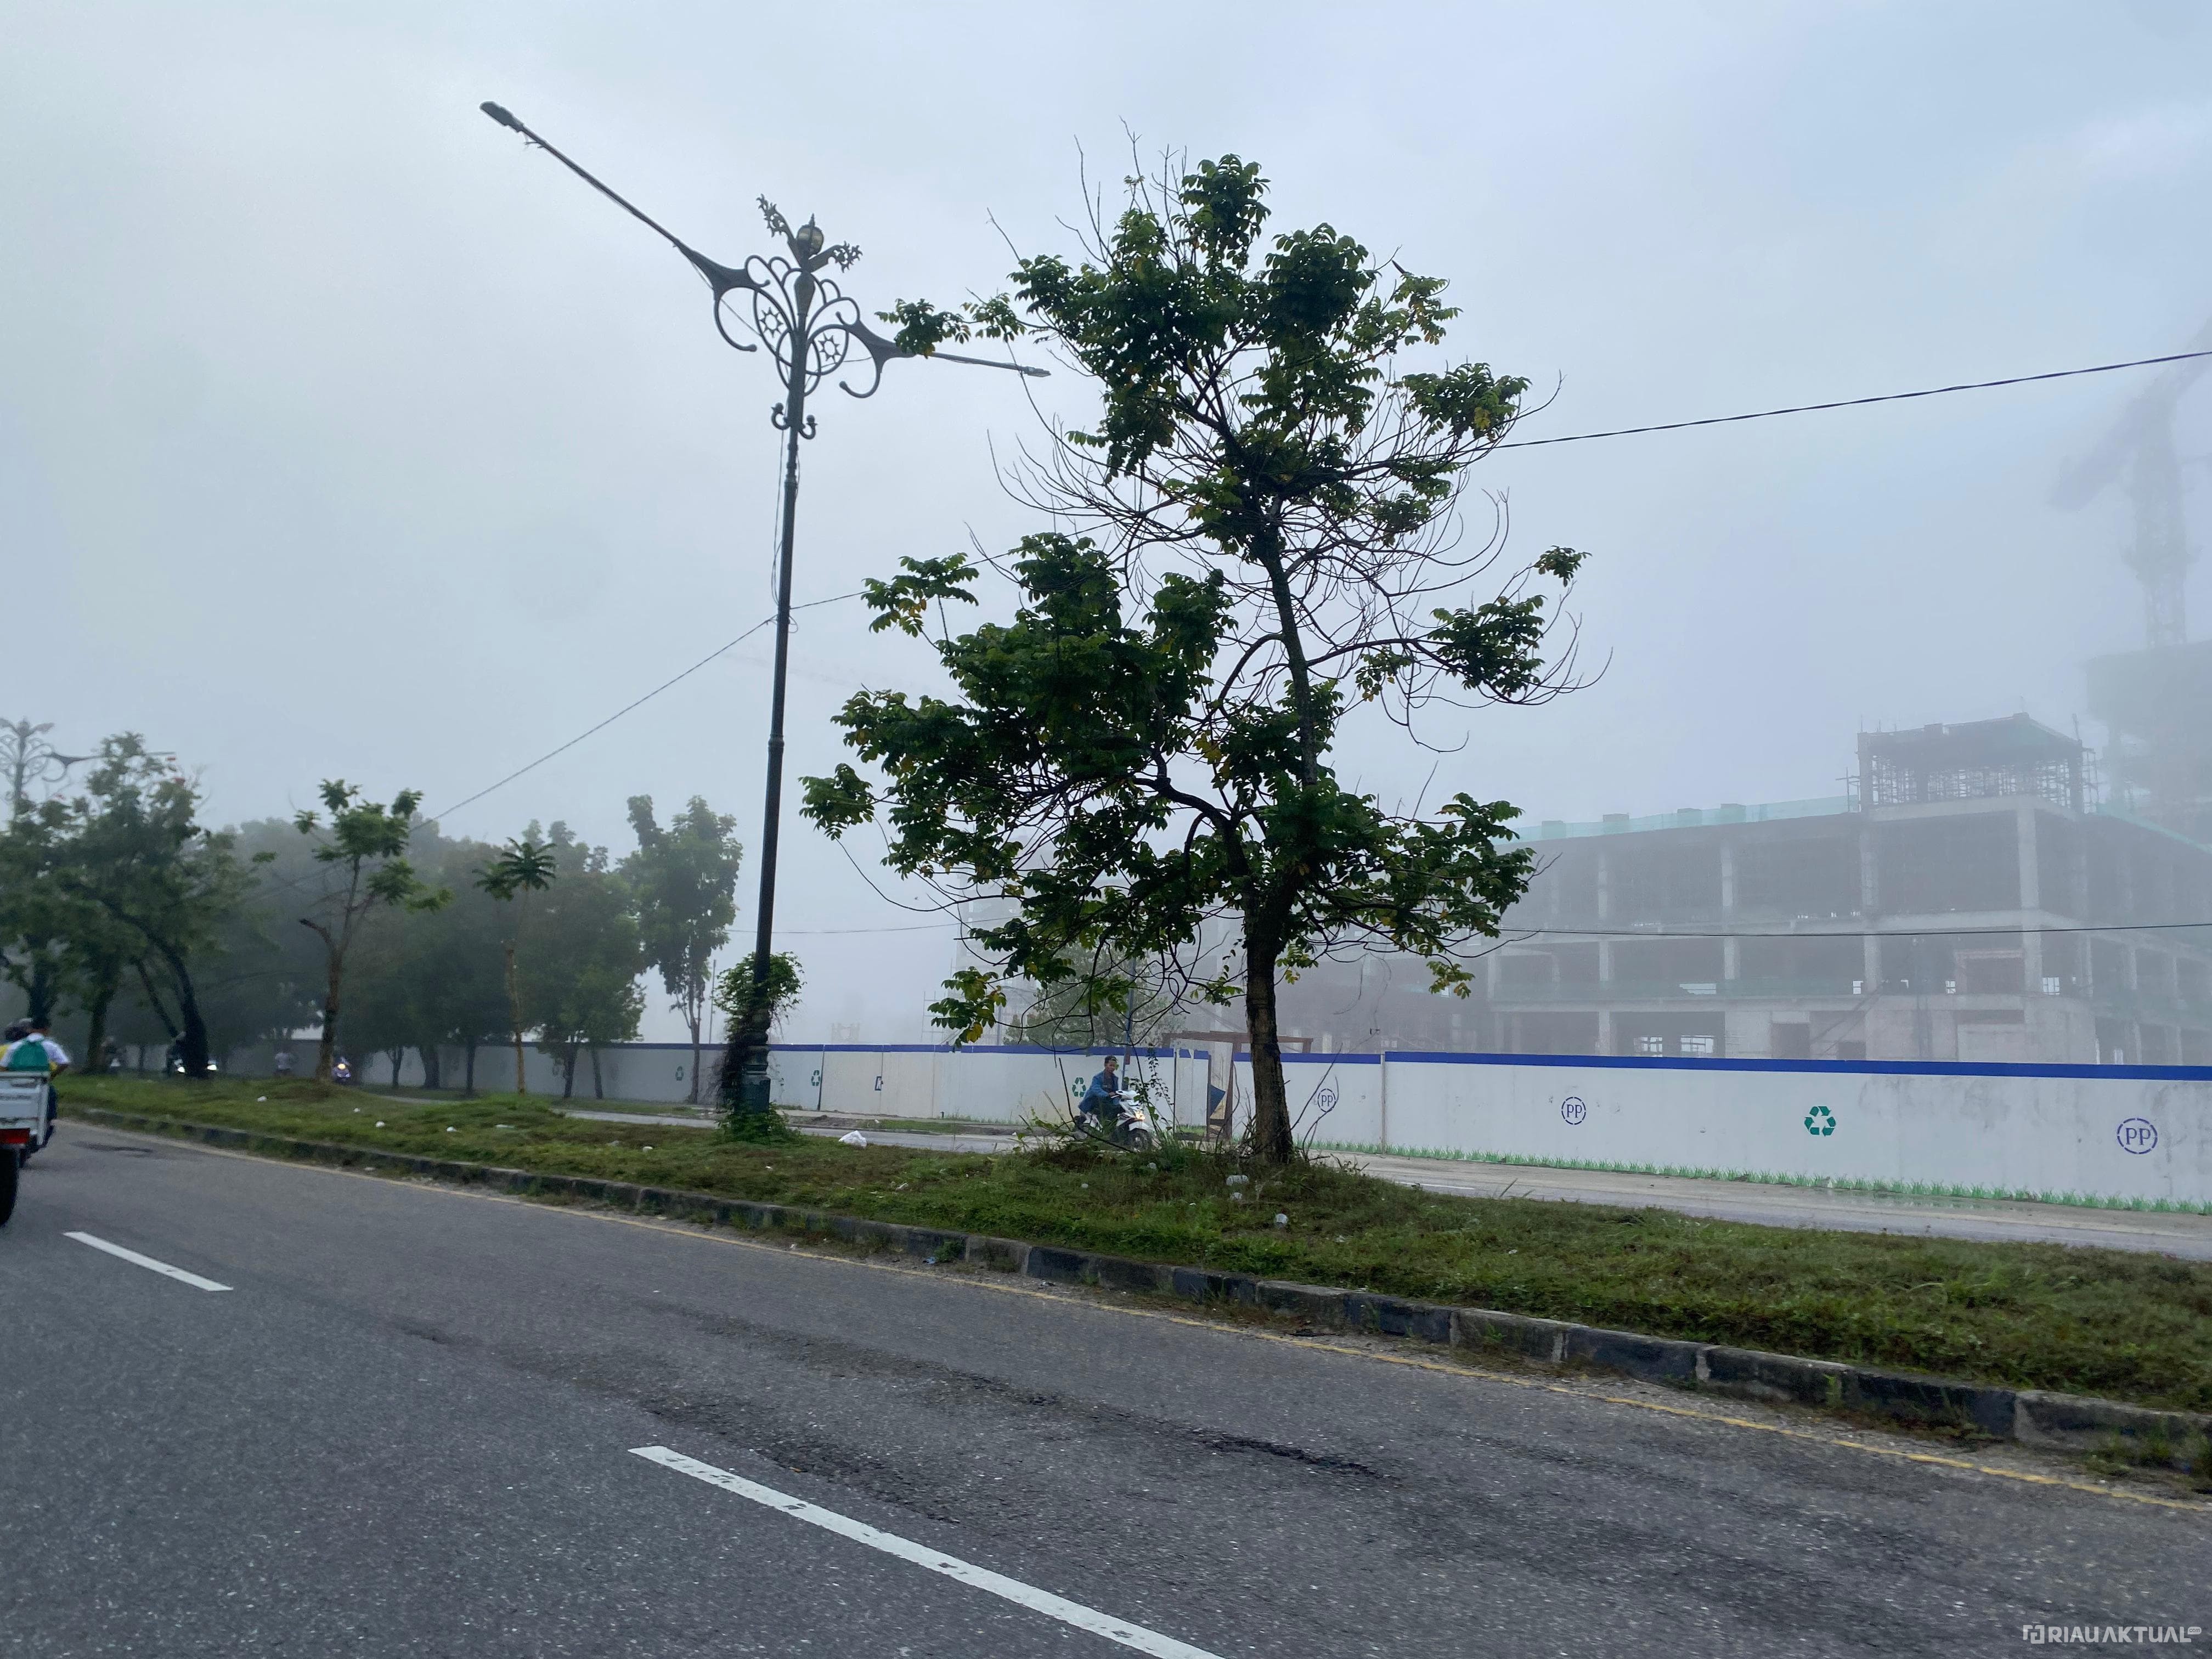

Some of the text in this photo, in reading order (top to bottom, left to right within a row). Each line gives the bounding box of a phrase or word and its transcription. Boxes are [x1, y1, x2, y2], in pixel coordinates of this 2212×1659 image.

[1321, 1095, 1333, 1107] PP
[1567, 1104, 1582, 1118] PP
[2125, 1127, 2151, 1145] PP
